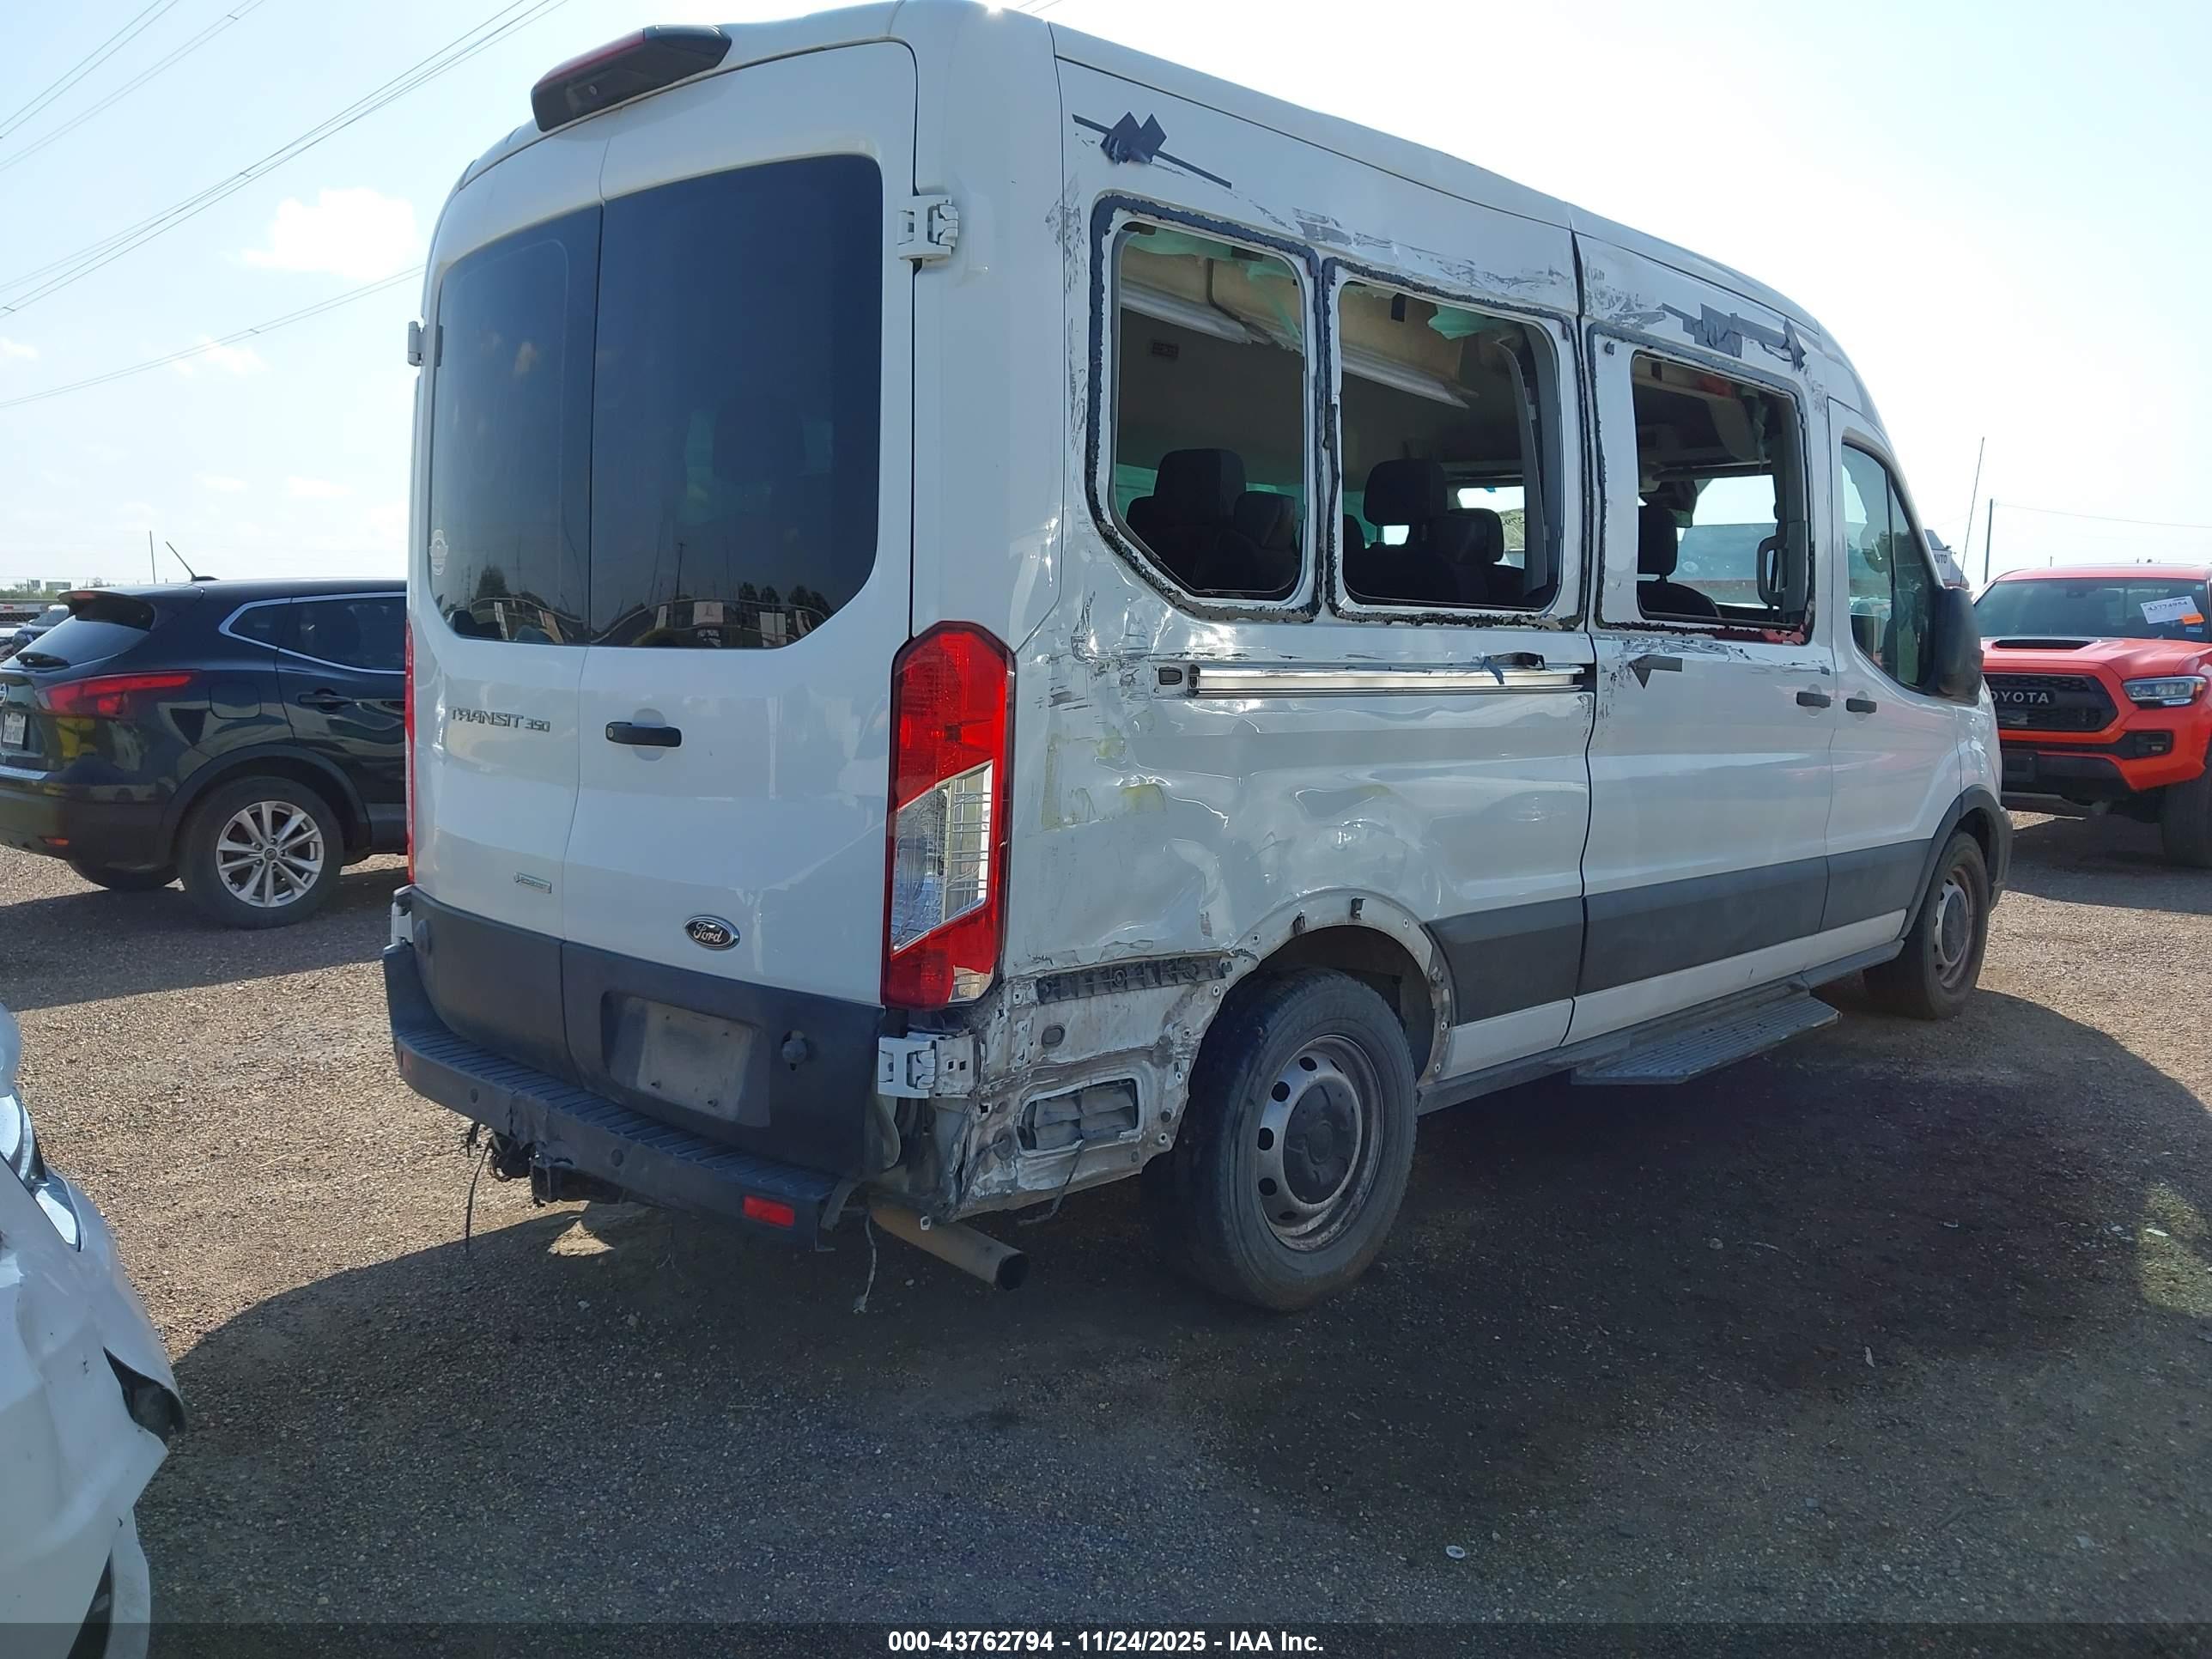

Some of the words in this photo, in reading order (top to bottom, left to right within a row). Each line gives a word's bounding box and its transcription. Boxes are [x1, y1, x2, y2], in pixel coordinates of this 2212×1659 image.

[1991, 691, 2050, 703] OYOTA
[448, 707, 525, 729] TRANSIT
[525, 718, 550, 732] 350
[693, 921, 723, 943] Ford
